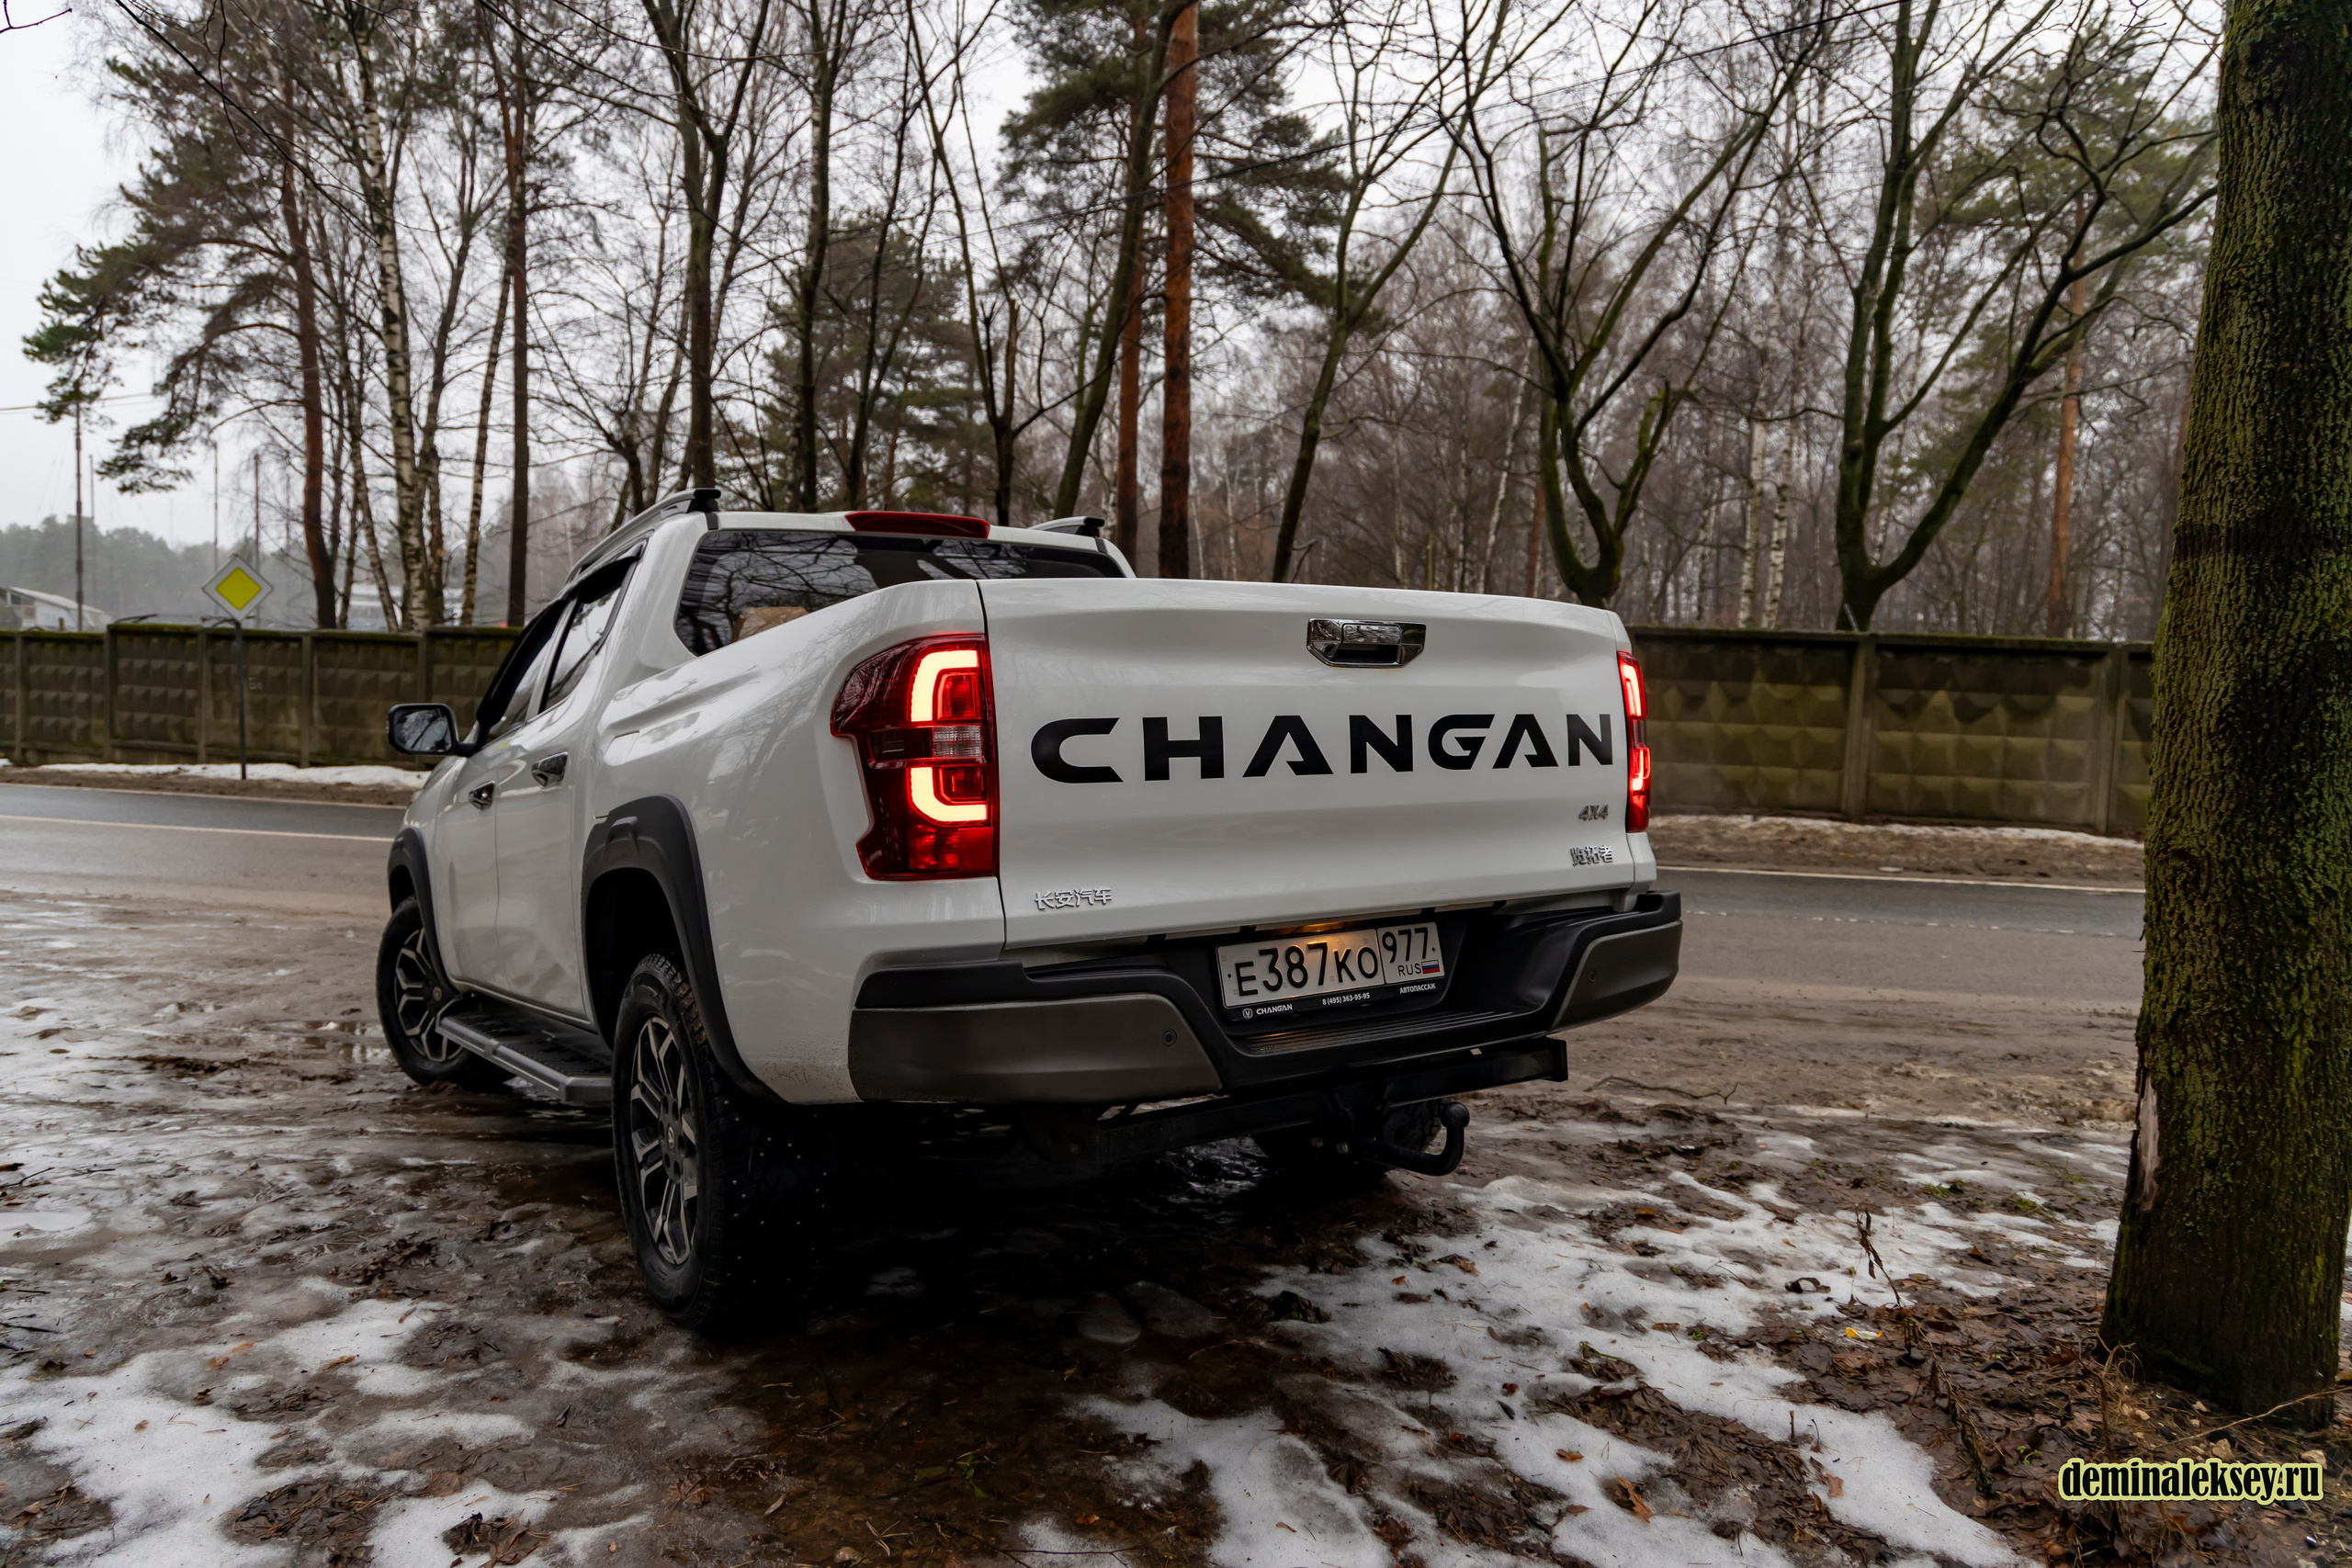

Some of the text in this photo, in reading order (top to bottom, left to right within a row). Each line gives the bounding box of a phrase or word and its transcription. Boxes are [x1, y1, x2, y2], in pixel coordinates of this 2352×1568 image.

[1031, 714, 1613, 784] CHANGAN
[1035, 886, 1113, 910] 长安汽车
[1382, 927, 1430, 964] 977
[1397, 964, 1422, 977] RUS
[1399, 983, 1436, 994] АВТОПАССАЖ
[1328, 995, 1342, 1006] (495)
[1342, 992, 1370, 1003] 363-95-95
[1256, 1003, 1293, 1015] CHANGAN
